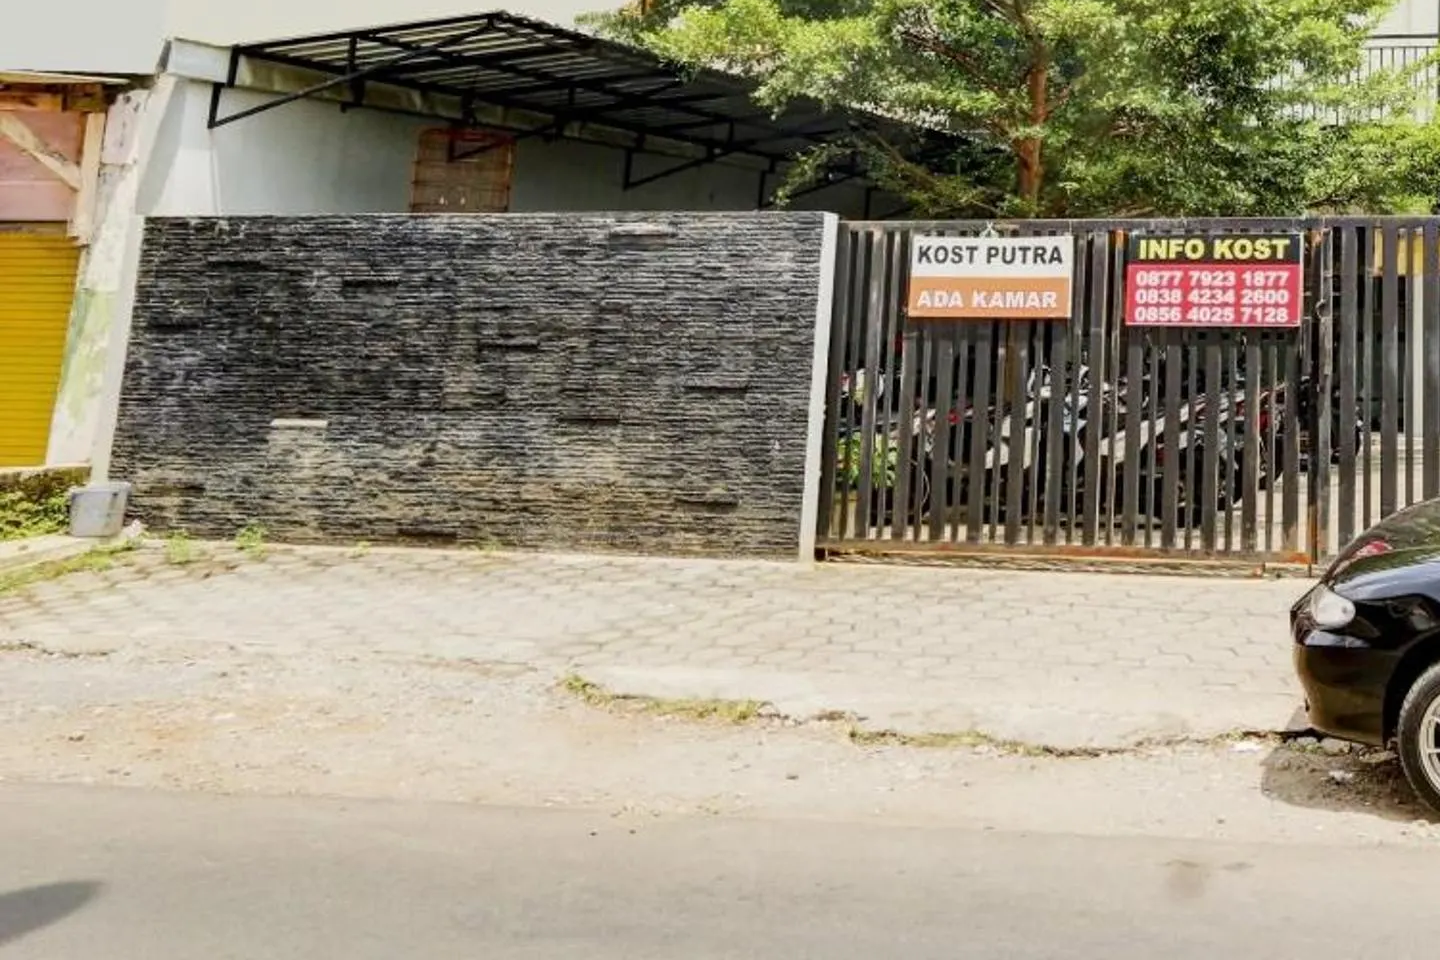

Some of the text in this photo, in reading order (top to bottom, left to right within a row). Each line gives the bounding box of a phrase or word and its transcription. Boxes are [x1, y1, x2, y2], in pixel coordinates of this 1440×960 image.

[917, 245, 1063, 264] KOST PUTRA
[1138, 238, 1290, 260] INFO KOST
[1135, 270, 1290, 286] 0877 7923 1877
[916, 290, 1057, 308] ADA KAMAR
[1135, 288, 1182, 304] 0838
[1187, 288, 1235, 304] 4234
[1134, 307, 1288, 322] 0856 4025 7128
